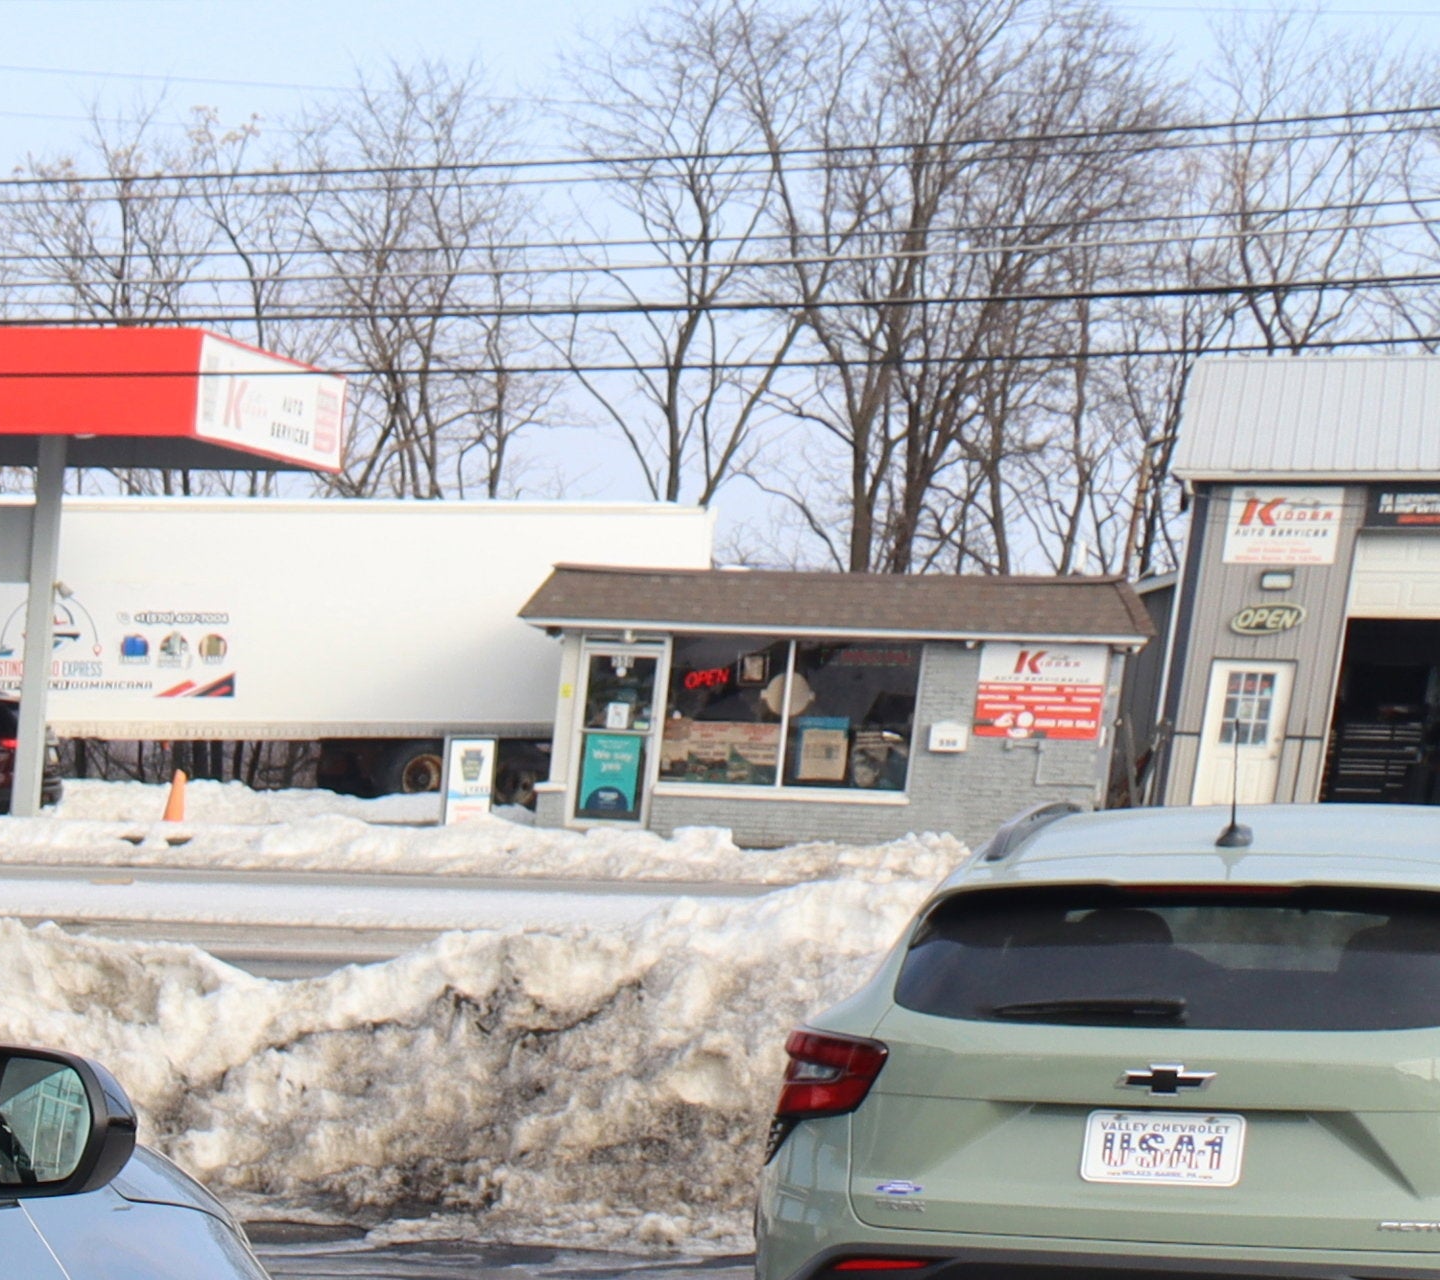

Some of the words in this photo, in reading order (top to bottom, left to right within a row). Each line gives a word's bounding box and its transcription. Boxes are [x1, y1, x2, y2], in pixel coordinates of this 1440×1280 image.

[282, 396, 304, 416] AUTO
[271, 421, 310, 446] SERVICES
[1234, 528, 1265, 537] AUTO
[1270, 528, 1329, 538] SERVICES
[1237, 608, 1300, 629] OPEN
[62, 661, 103, 678] EXPRESS
[684, 667, 730, 690] OPEN
[71, 680, 153, 691] DOMINICANA
[1101, 1121, 1149, 1132] VALLEY
[1152, 1123, 1231, 1134] CHEVROLET
